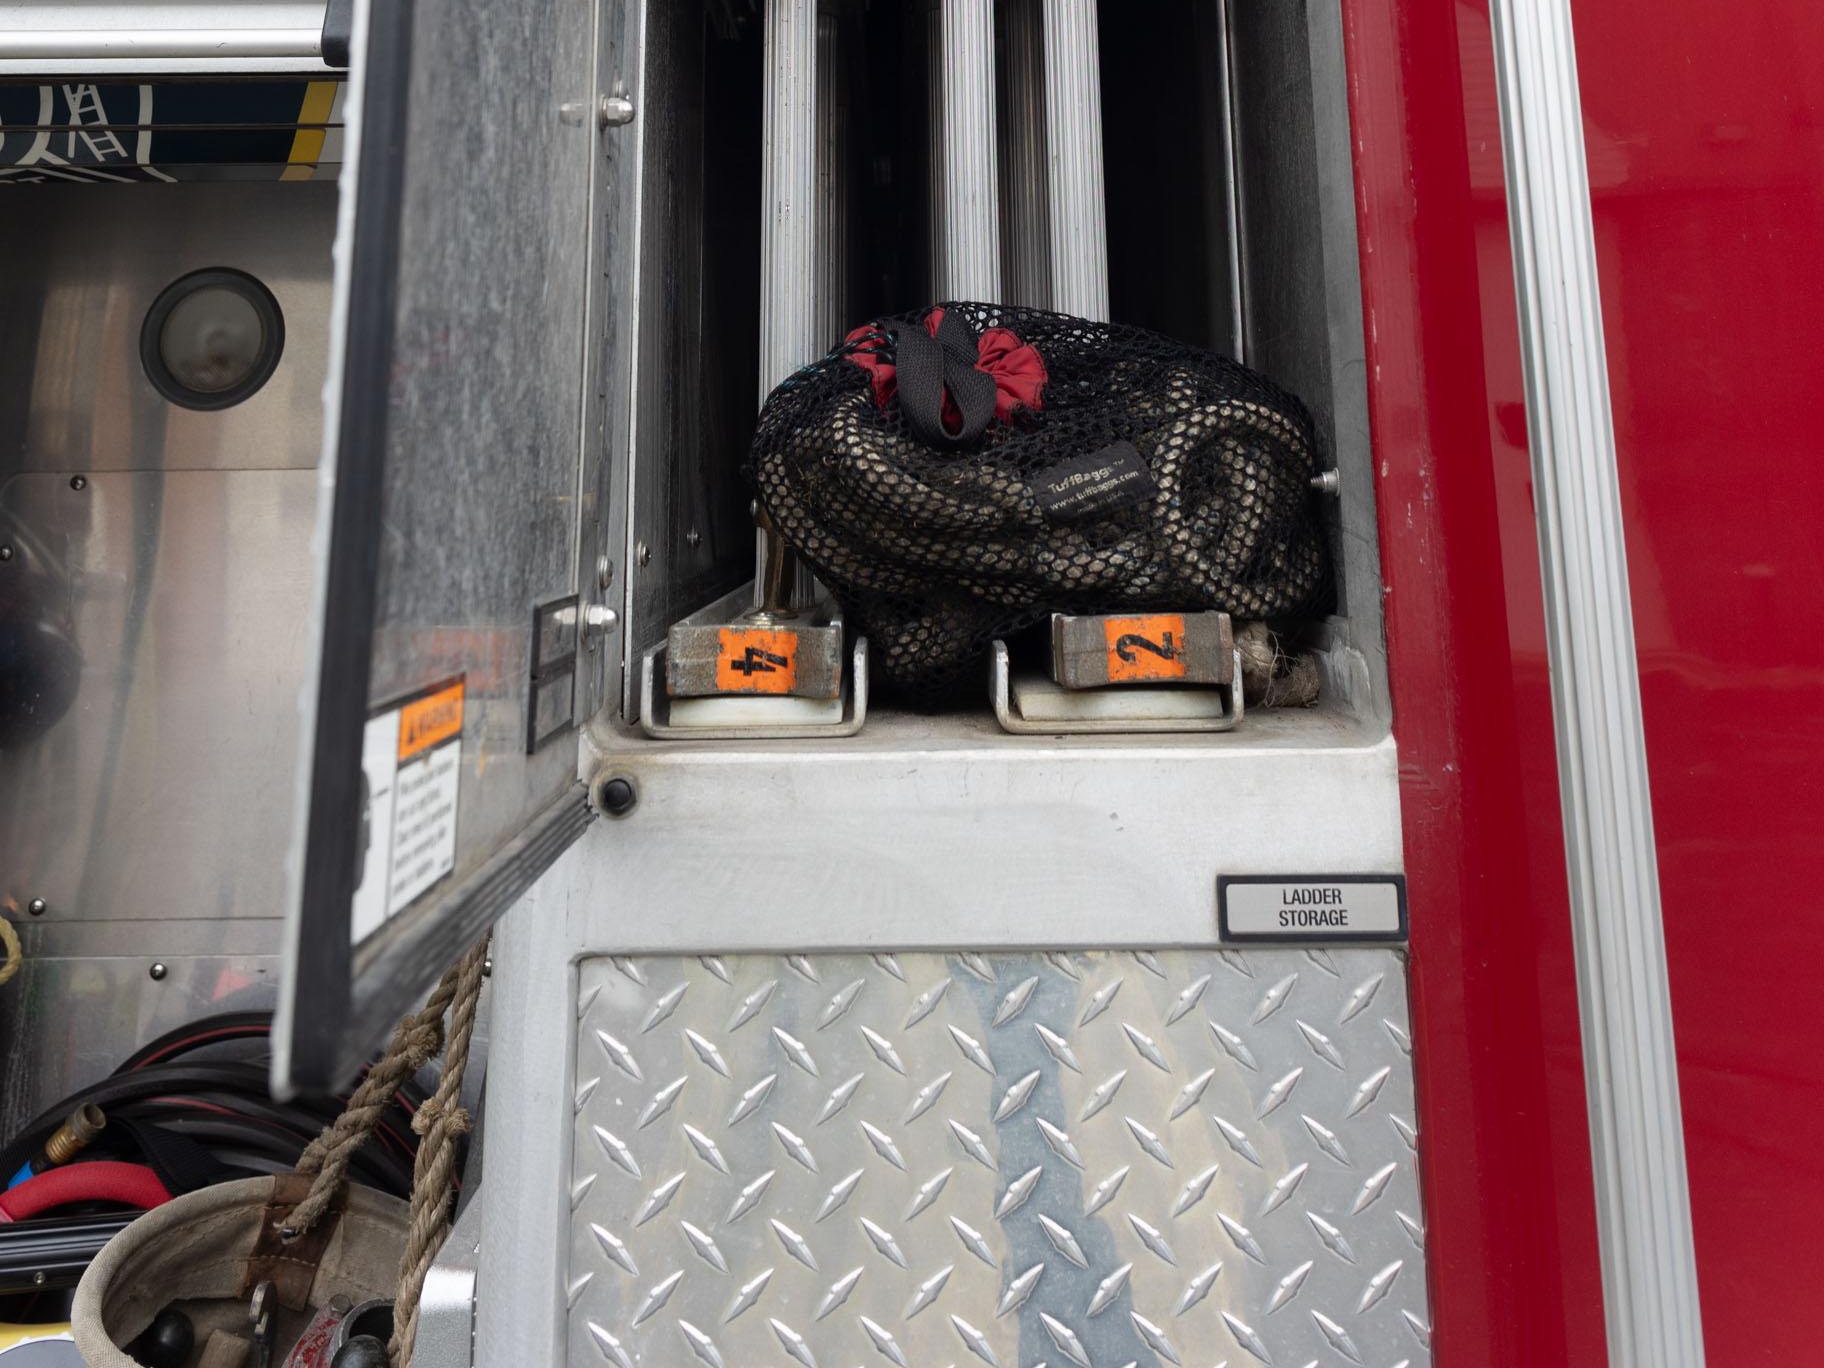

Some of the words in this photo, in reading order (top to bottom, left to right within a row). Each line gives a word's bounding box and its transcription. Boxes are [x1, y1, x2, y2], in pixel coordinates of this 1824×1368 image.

[1116, 632, 1174, 663] 2
[731, 647, 788, 676] 4
[1283, 888, 1343, 905] LADDER
[1279, 909, 1349, 926] STORAGE
